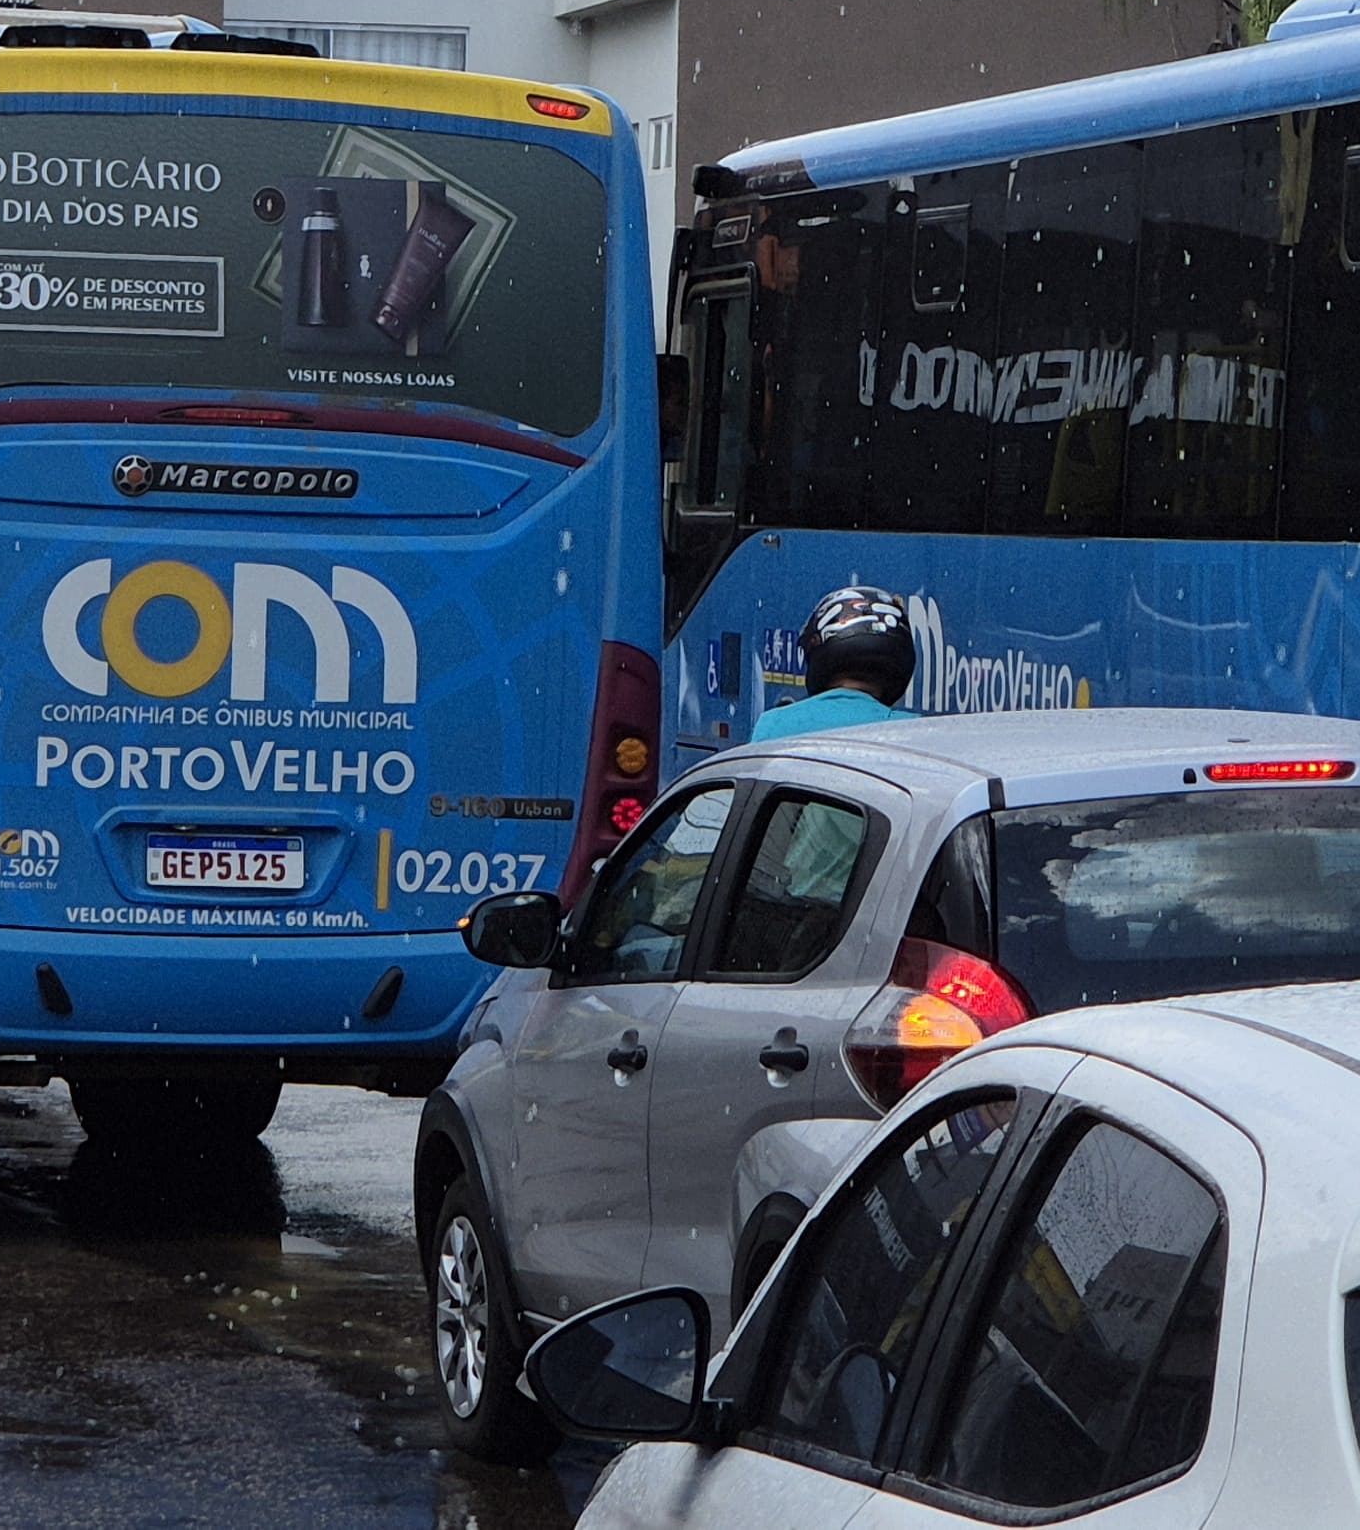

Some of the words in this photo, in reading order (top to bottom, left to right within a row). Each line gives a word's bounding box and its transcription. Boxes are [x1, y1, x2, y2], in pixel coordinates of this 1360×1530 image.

[3, 199, 54, 223] DIA
[63, 201, 125, 226] DOS
[134, 204, 199, 229] PAIS
[83, 277, 107, 293] DE
[111, 278, 205, 296] DESCONTO
[83, 296, 108, 310] EM
[111, 296, 205, 314] PRESENTES
[288, 369, 338, 384] VISITE
[342, 370, 403, 385] NOSSAS
[407, 372, 456, 387] LOJAS
[159, 464, 354, 494] Marcopolo
[41, 704, 175, 725] COMPANHIA
[181, 707, 209, 726] DE
[215, 699, 293, 728] ÔNIBUS
[299, 709, 415, 730] MUNICIPAL
[430, 795, 507, 818] 9-160
[513, 802, 562, 817] Urban
[396, 849, 547, 895] 02.037
[66, 907, 186, 925] VELOCIDADE
[191, 905, 281, 927] MÁXIMA:
[285, 911, 308, 927] 60
[313, 911, 369, 929] Km/h.
